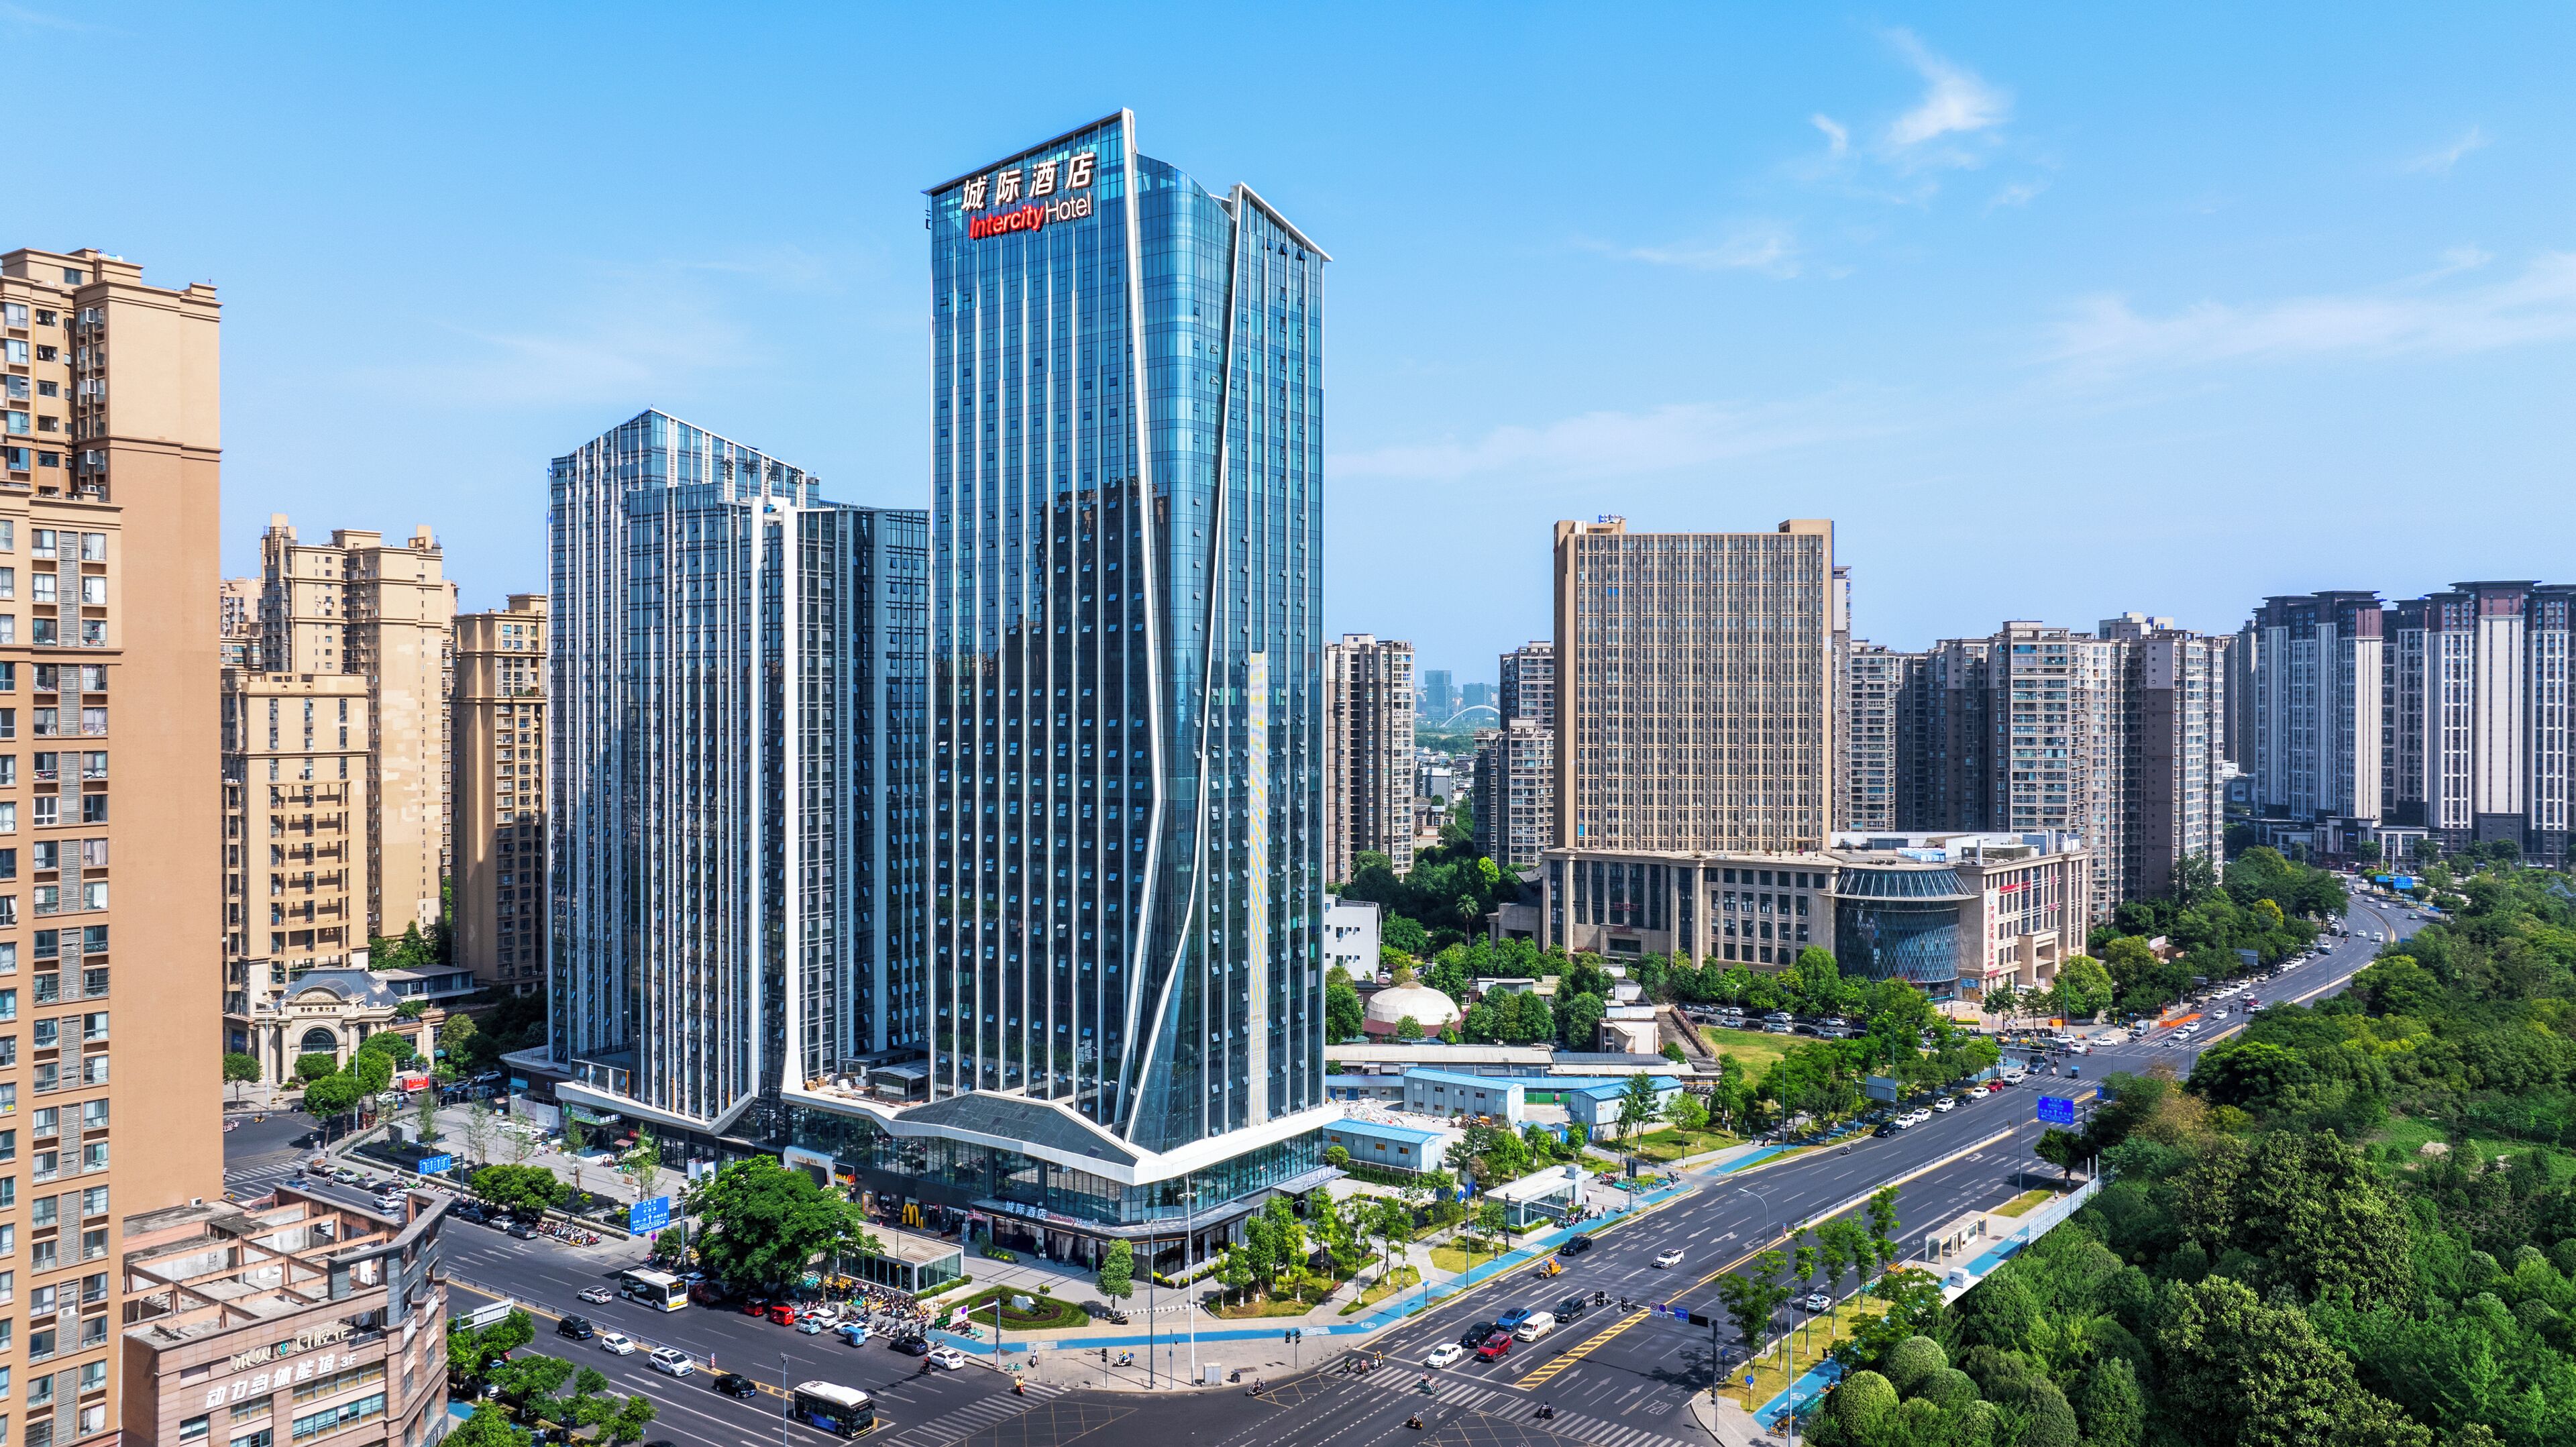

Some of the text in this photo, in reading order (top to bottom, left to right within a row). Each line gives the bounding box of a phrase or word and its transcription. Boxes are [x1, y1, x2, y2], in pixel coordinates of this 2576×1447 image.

[961, 152, 1095, 211] 城际酒店
[1005, 1200, 1047, 1220] 城际酒店
[341, 1353, 357, 1368] 3F
